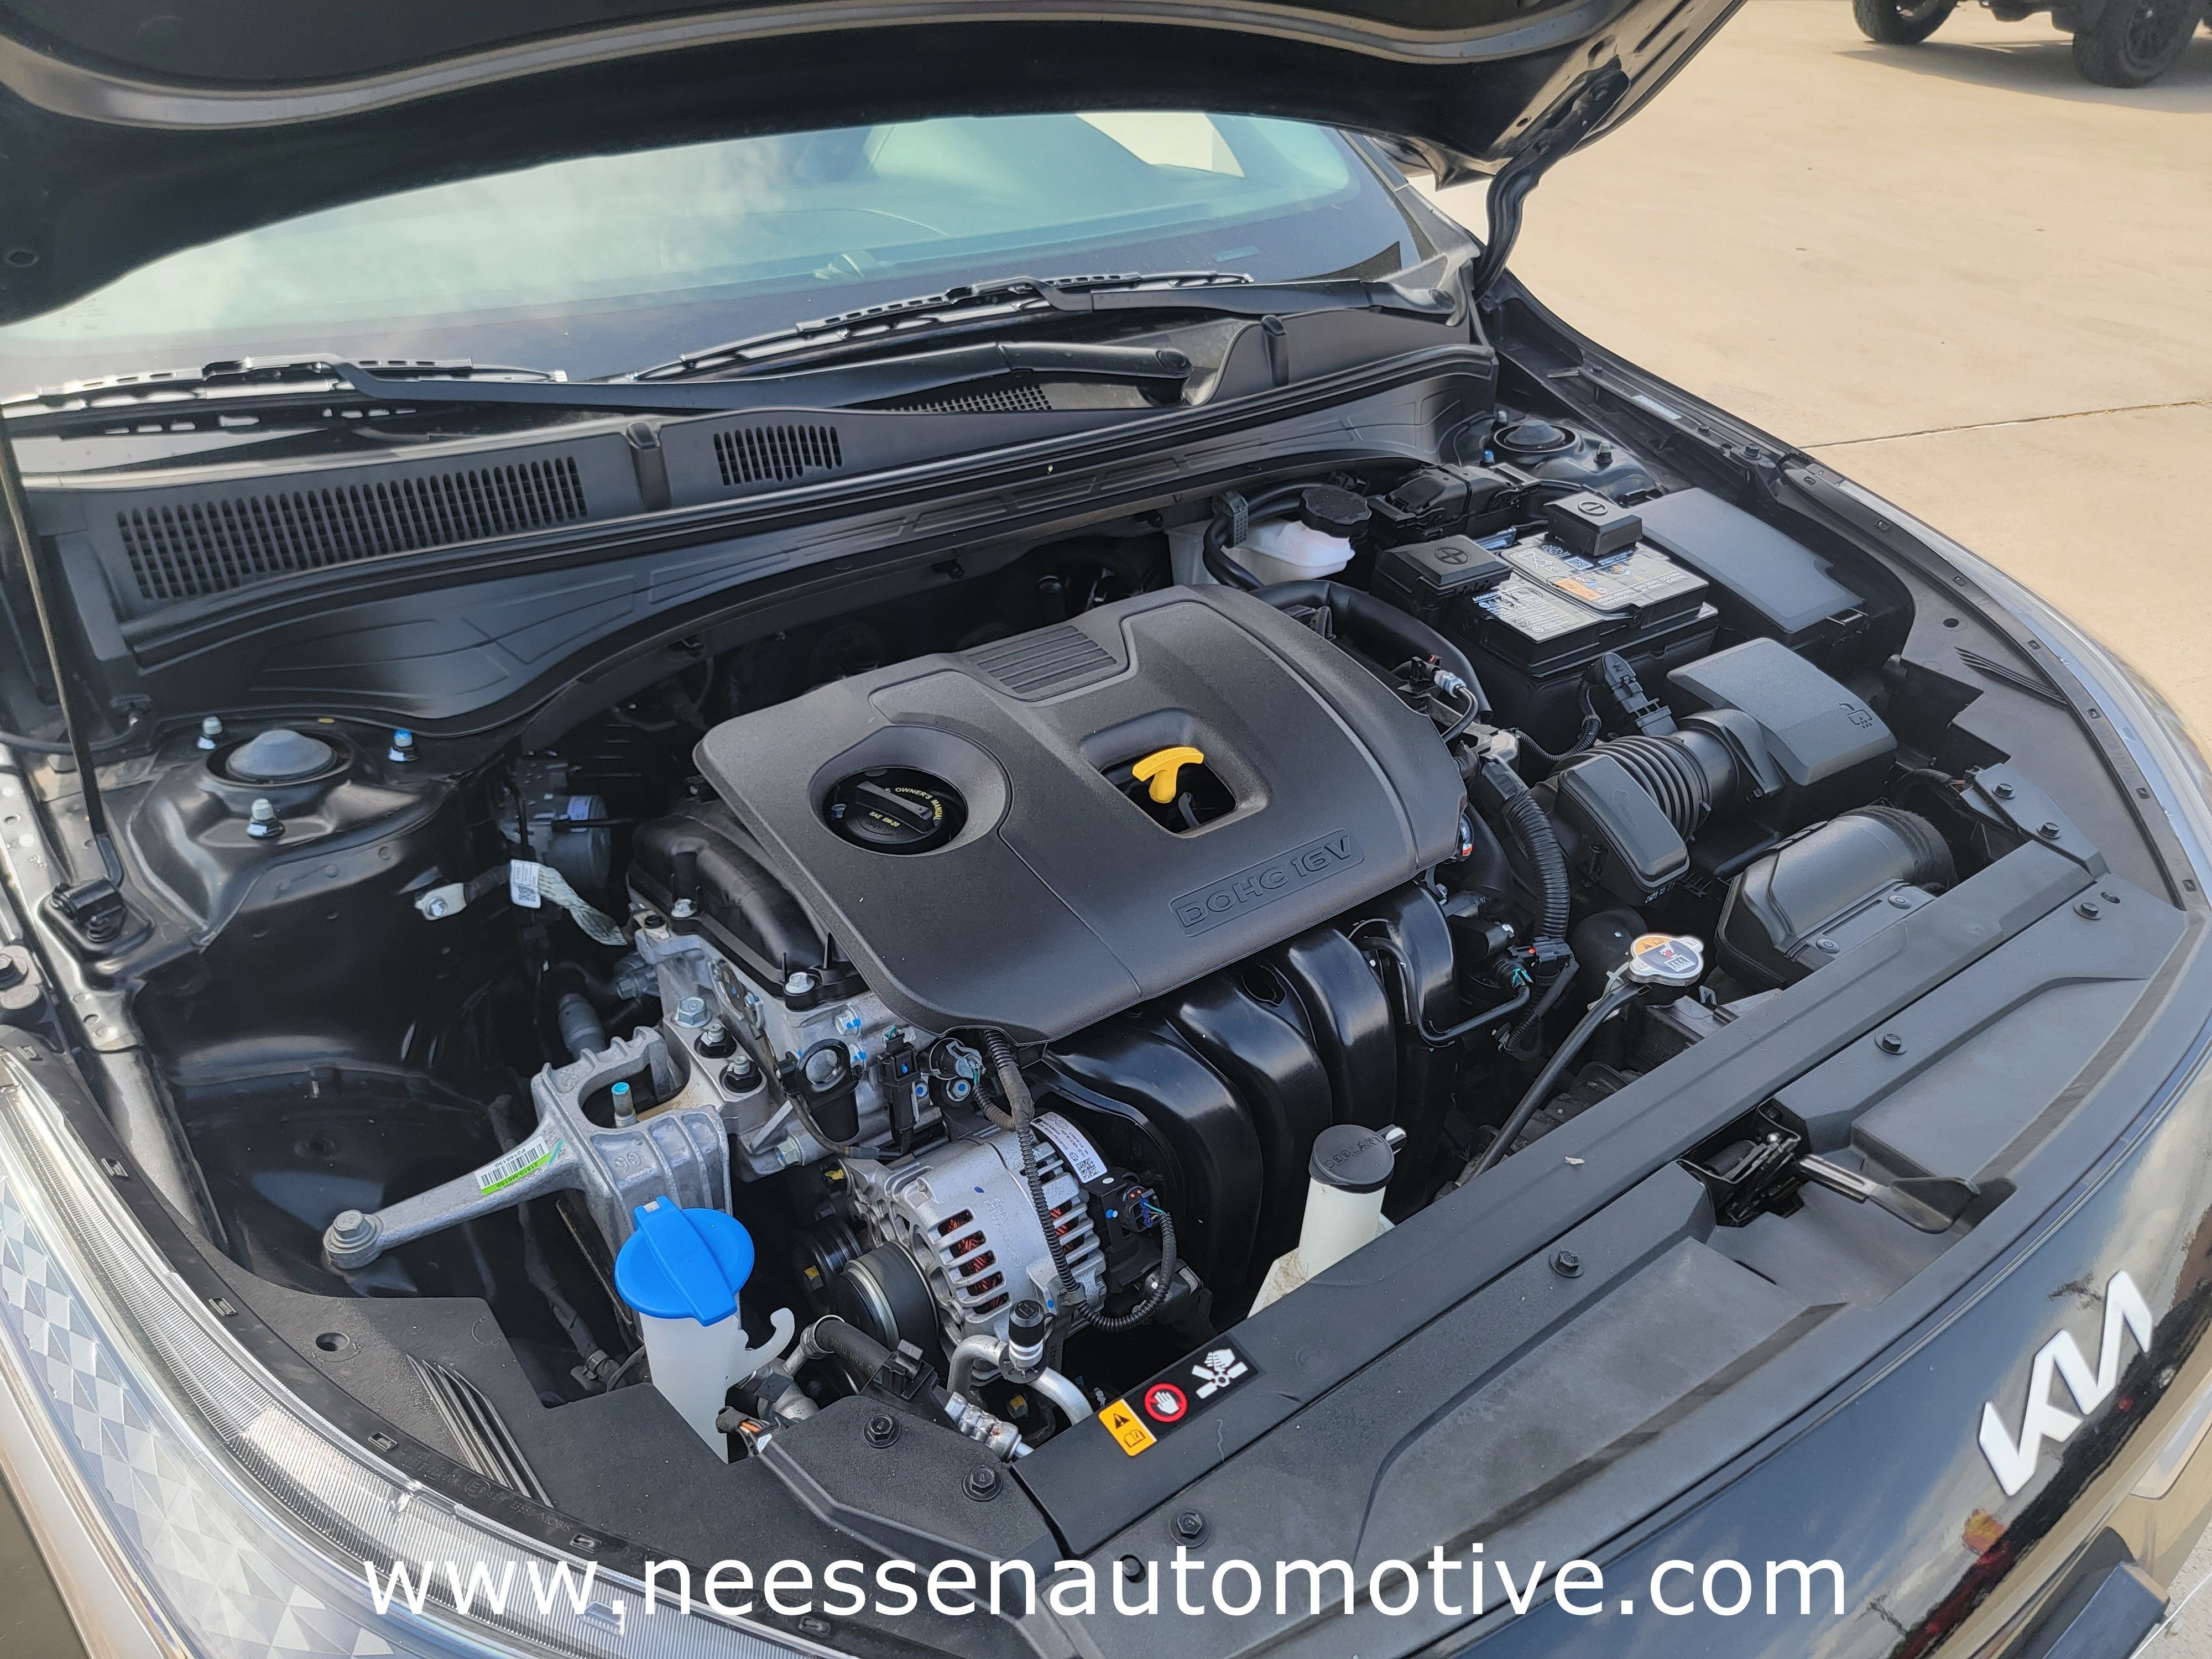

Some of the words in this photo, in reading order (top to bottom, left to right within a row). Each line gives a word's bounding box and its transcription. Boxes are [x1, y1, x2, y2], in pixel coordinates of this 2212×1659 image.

[869, 811, 883, 820] SAE
[895, 787, 933, 800] OWNER'S
[930, 799, 943, 821] MANUAL
[1176, 867, 1289, 928] DOHC
[1291, 835, 1352, 877] 16V
[1324, 1134, 1383, 1170] COOLANT
[1977, 1269, 2153, 1497] KIA
